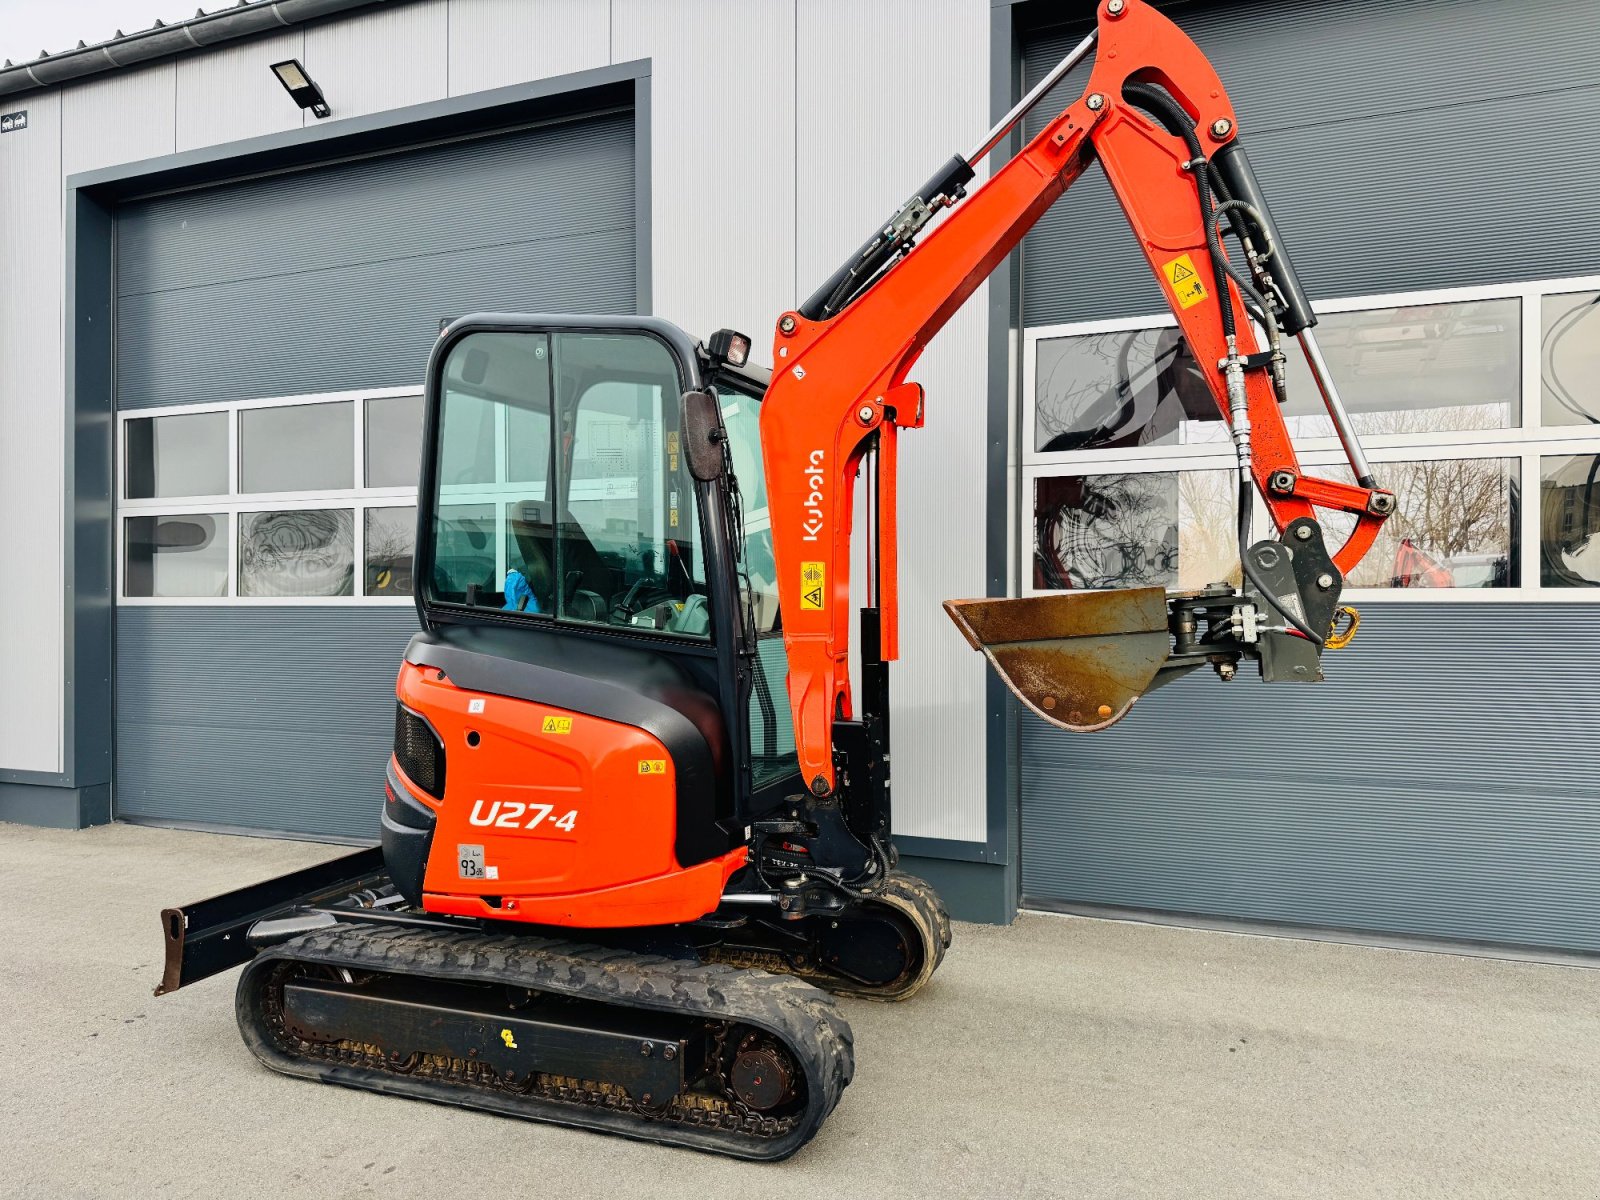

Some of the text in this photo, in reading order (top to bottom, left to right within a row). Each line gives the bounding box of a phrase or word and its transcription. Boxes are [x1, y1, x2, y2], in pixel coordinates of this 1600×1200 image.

[803, 450, 824, 541] Kubota
[469, 800, 578, 832] U27-4
[461, 859, 476, 876] 93
